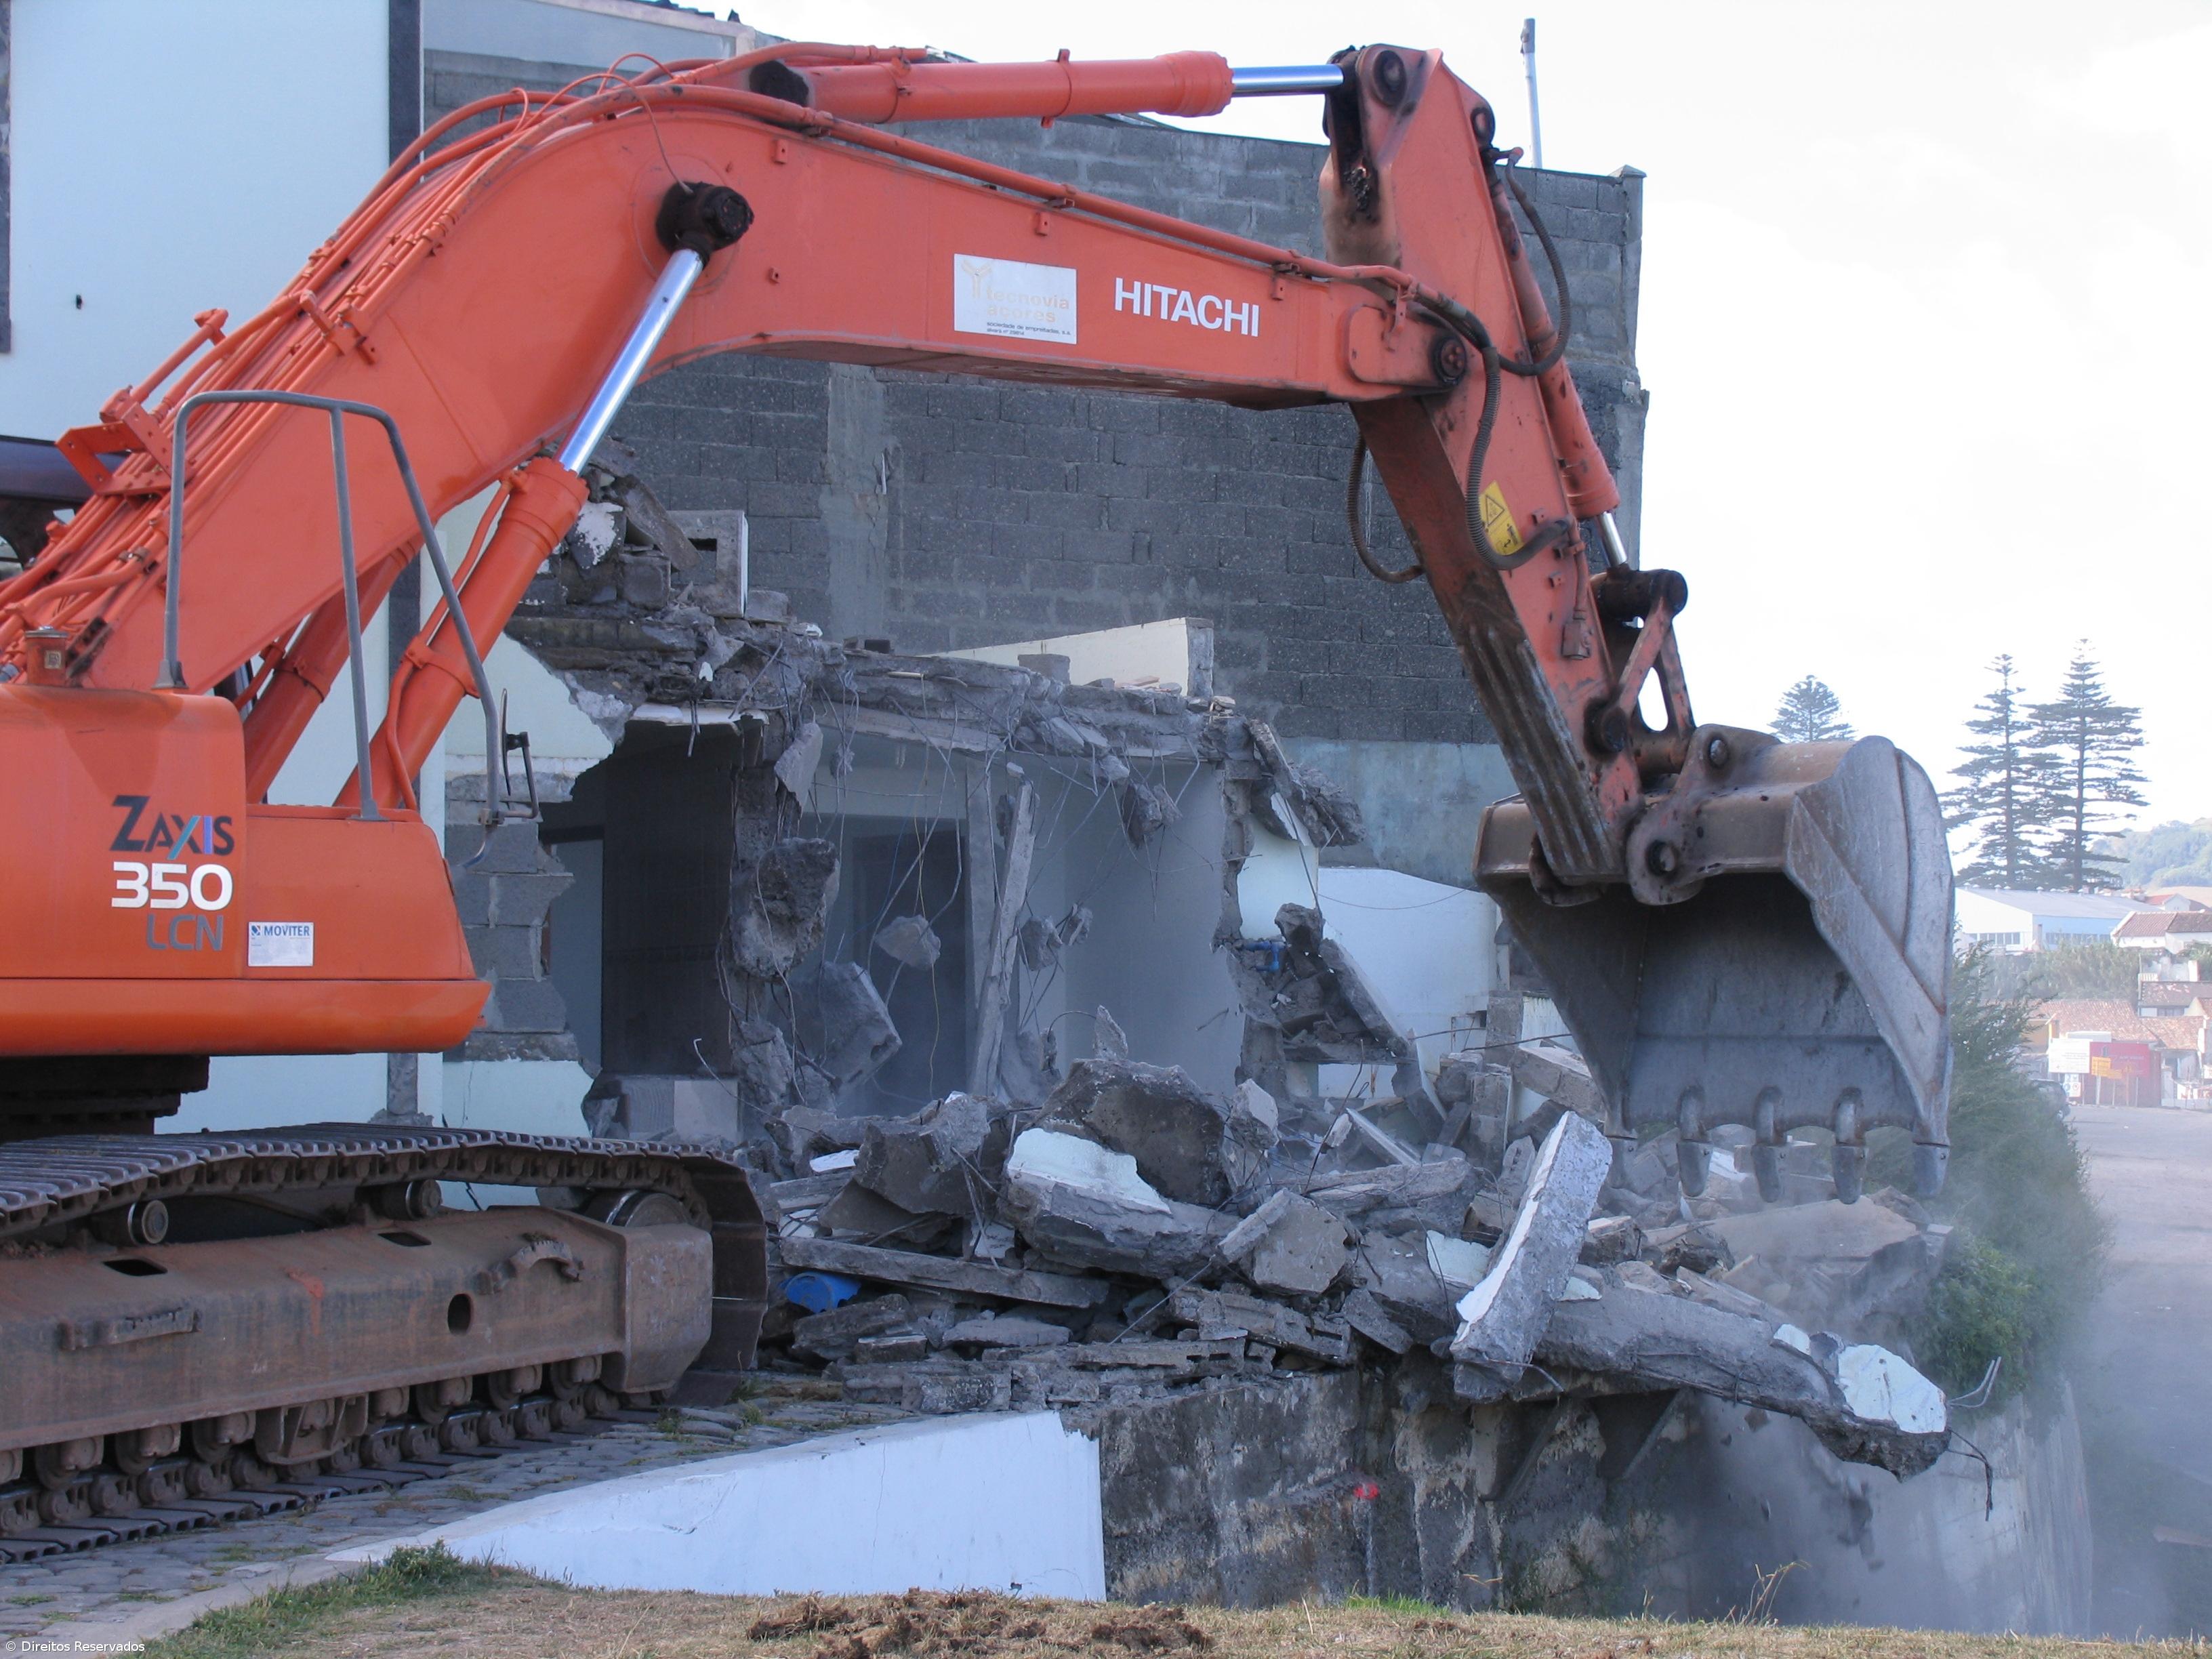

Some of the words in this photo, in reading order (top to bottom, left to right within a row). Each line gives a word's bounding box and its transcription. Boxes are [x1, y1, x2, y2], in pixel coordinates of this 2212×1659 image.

[986, 287, 1069, 310] tecnovia
[1114, 277, 1260, 337] HITACHI
[109, 794, 235, 860] ZAXIS
[111, 861, 234, 911] 350
[146, 914, 224, 951] LCN
[264, 925, 310, 937] MOVITER
